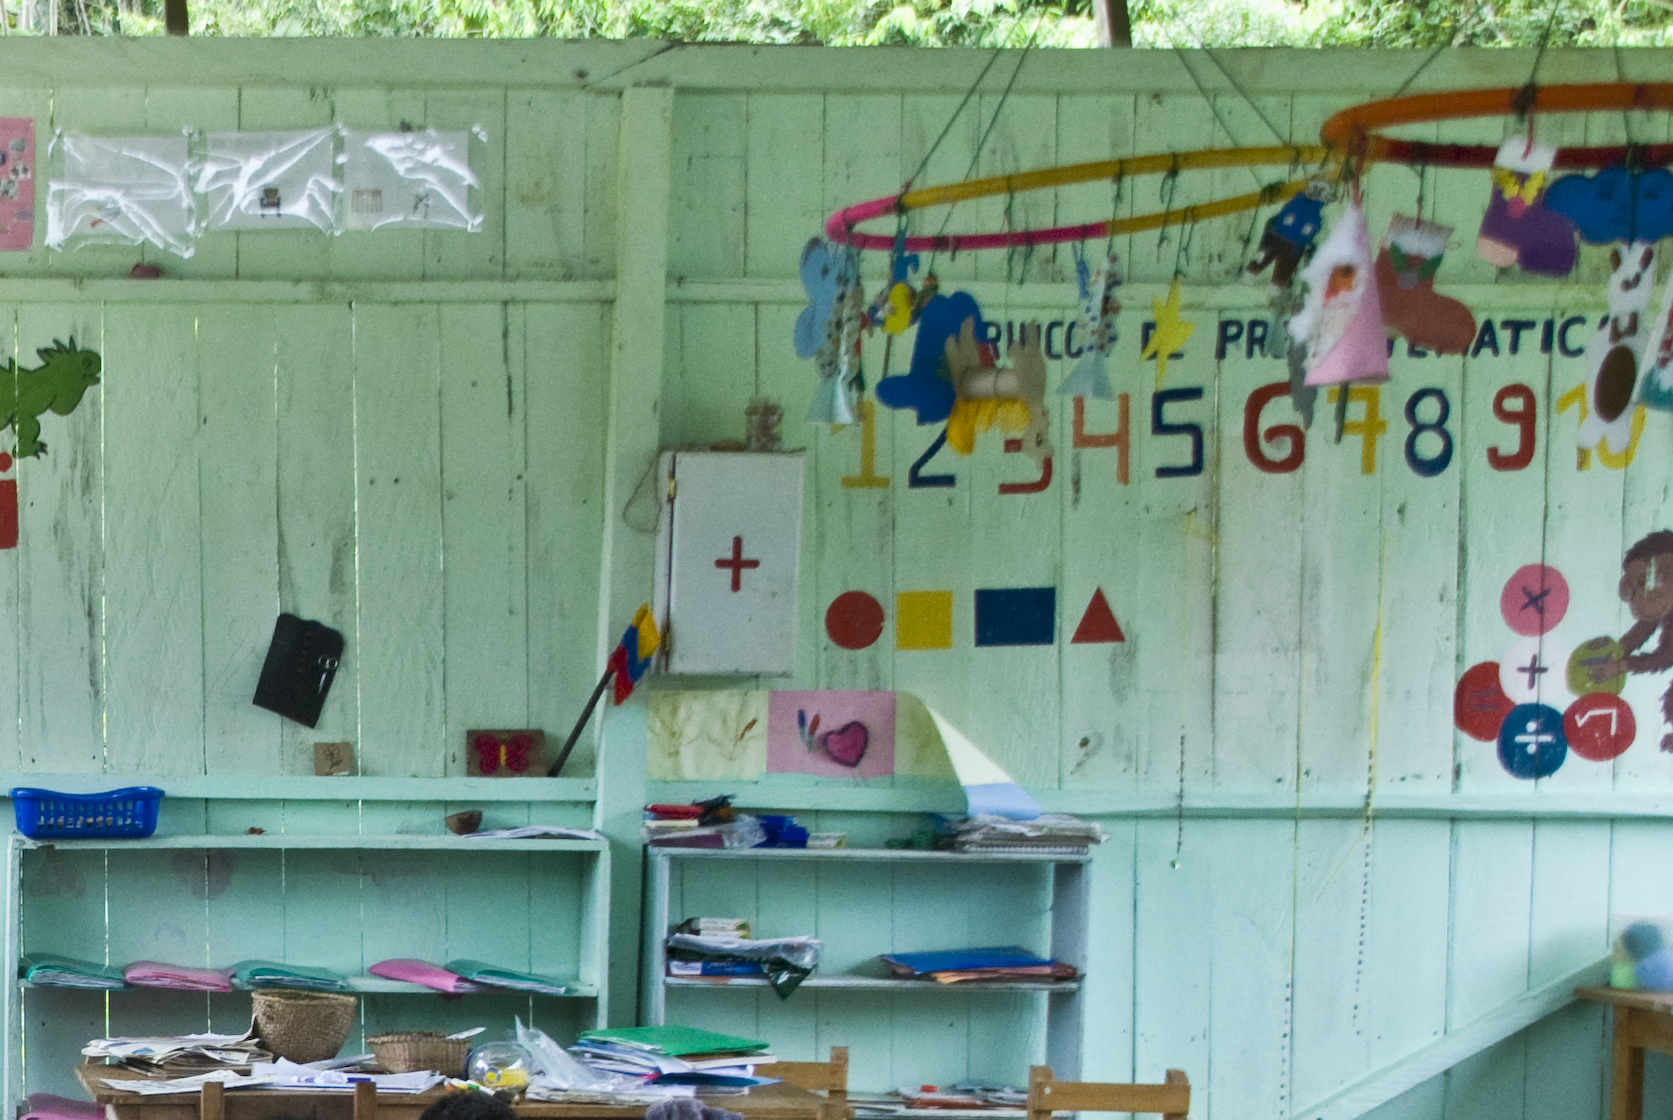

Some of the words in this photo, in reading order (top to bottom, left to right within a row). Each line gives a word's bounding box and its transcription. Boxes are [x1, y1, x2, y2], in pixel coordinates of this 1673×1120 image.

[831, 400, 890, 488] 1
[1073, 392, 1130, 485] 4
[1152, 386, 1203, 478] 5
[1243, 381, 1305, 474] 6
[1327, 386, 1387, 475] 7
[1404, 387, 1453, 477] 8
[1487, 383, 1536, 472] 9
